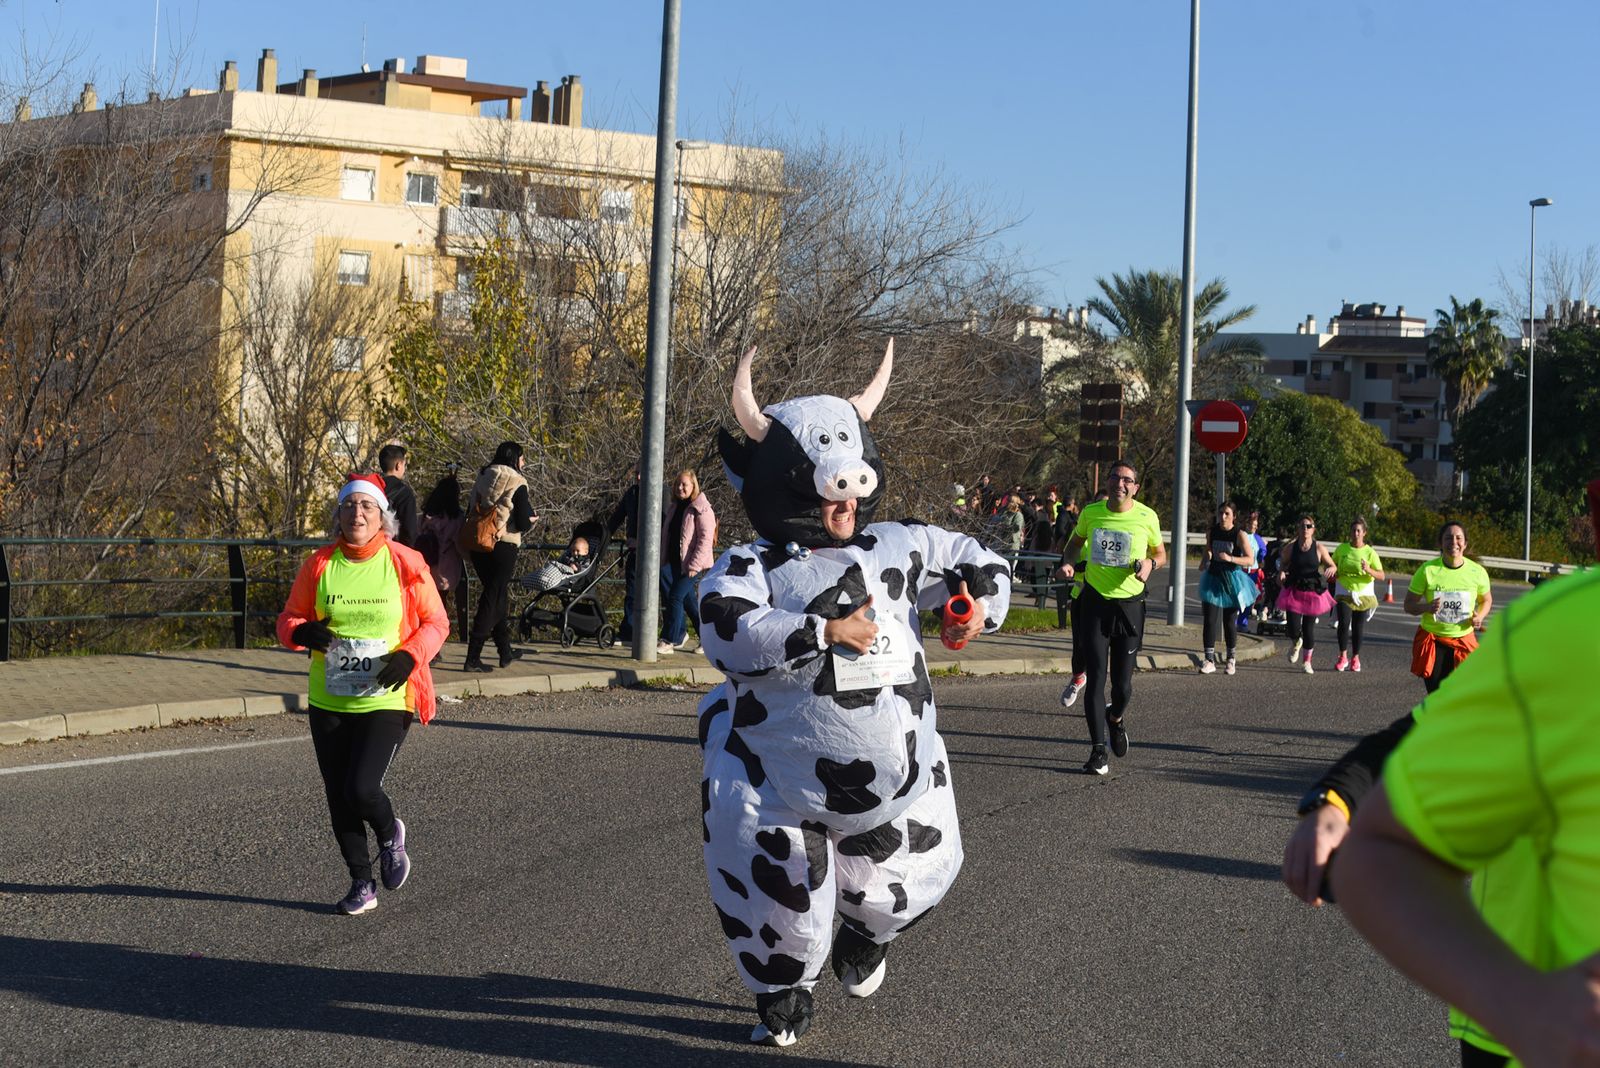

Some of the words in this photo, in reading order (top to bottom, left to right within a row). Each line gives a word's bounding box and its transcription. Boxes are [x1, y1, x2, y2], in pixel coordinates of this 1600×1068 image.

[1101, 540, 1122, 552] 925
[1443, 600, 1462, 610] 982
[340, 656, 372, 672] 220
